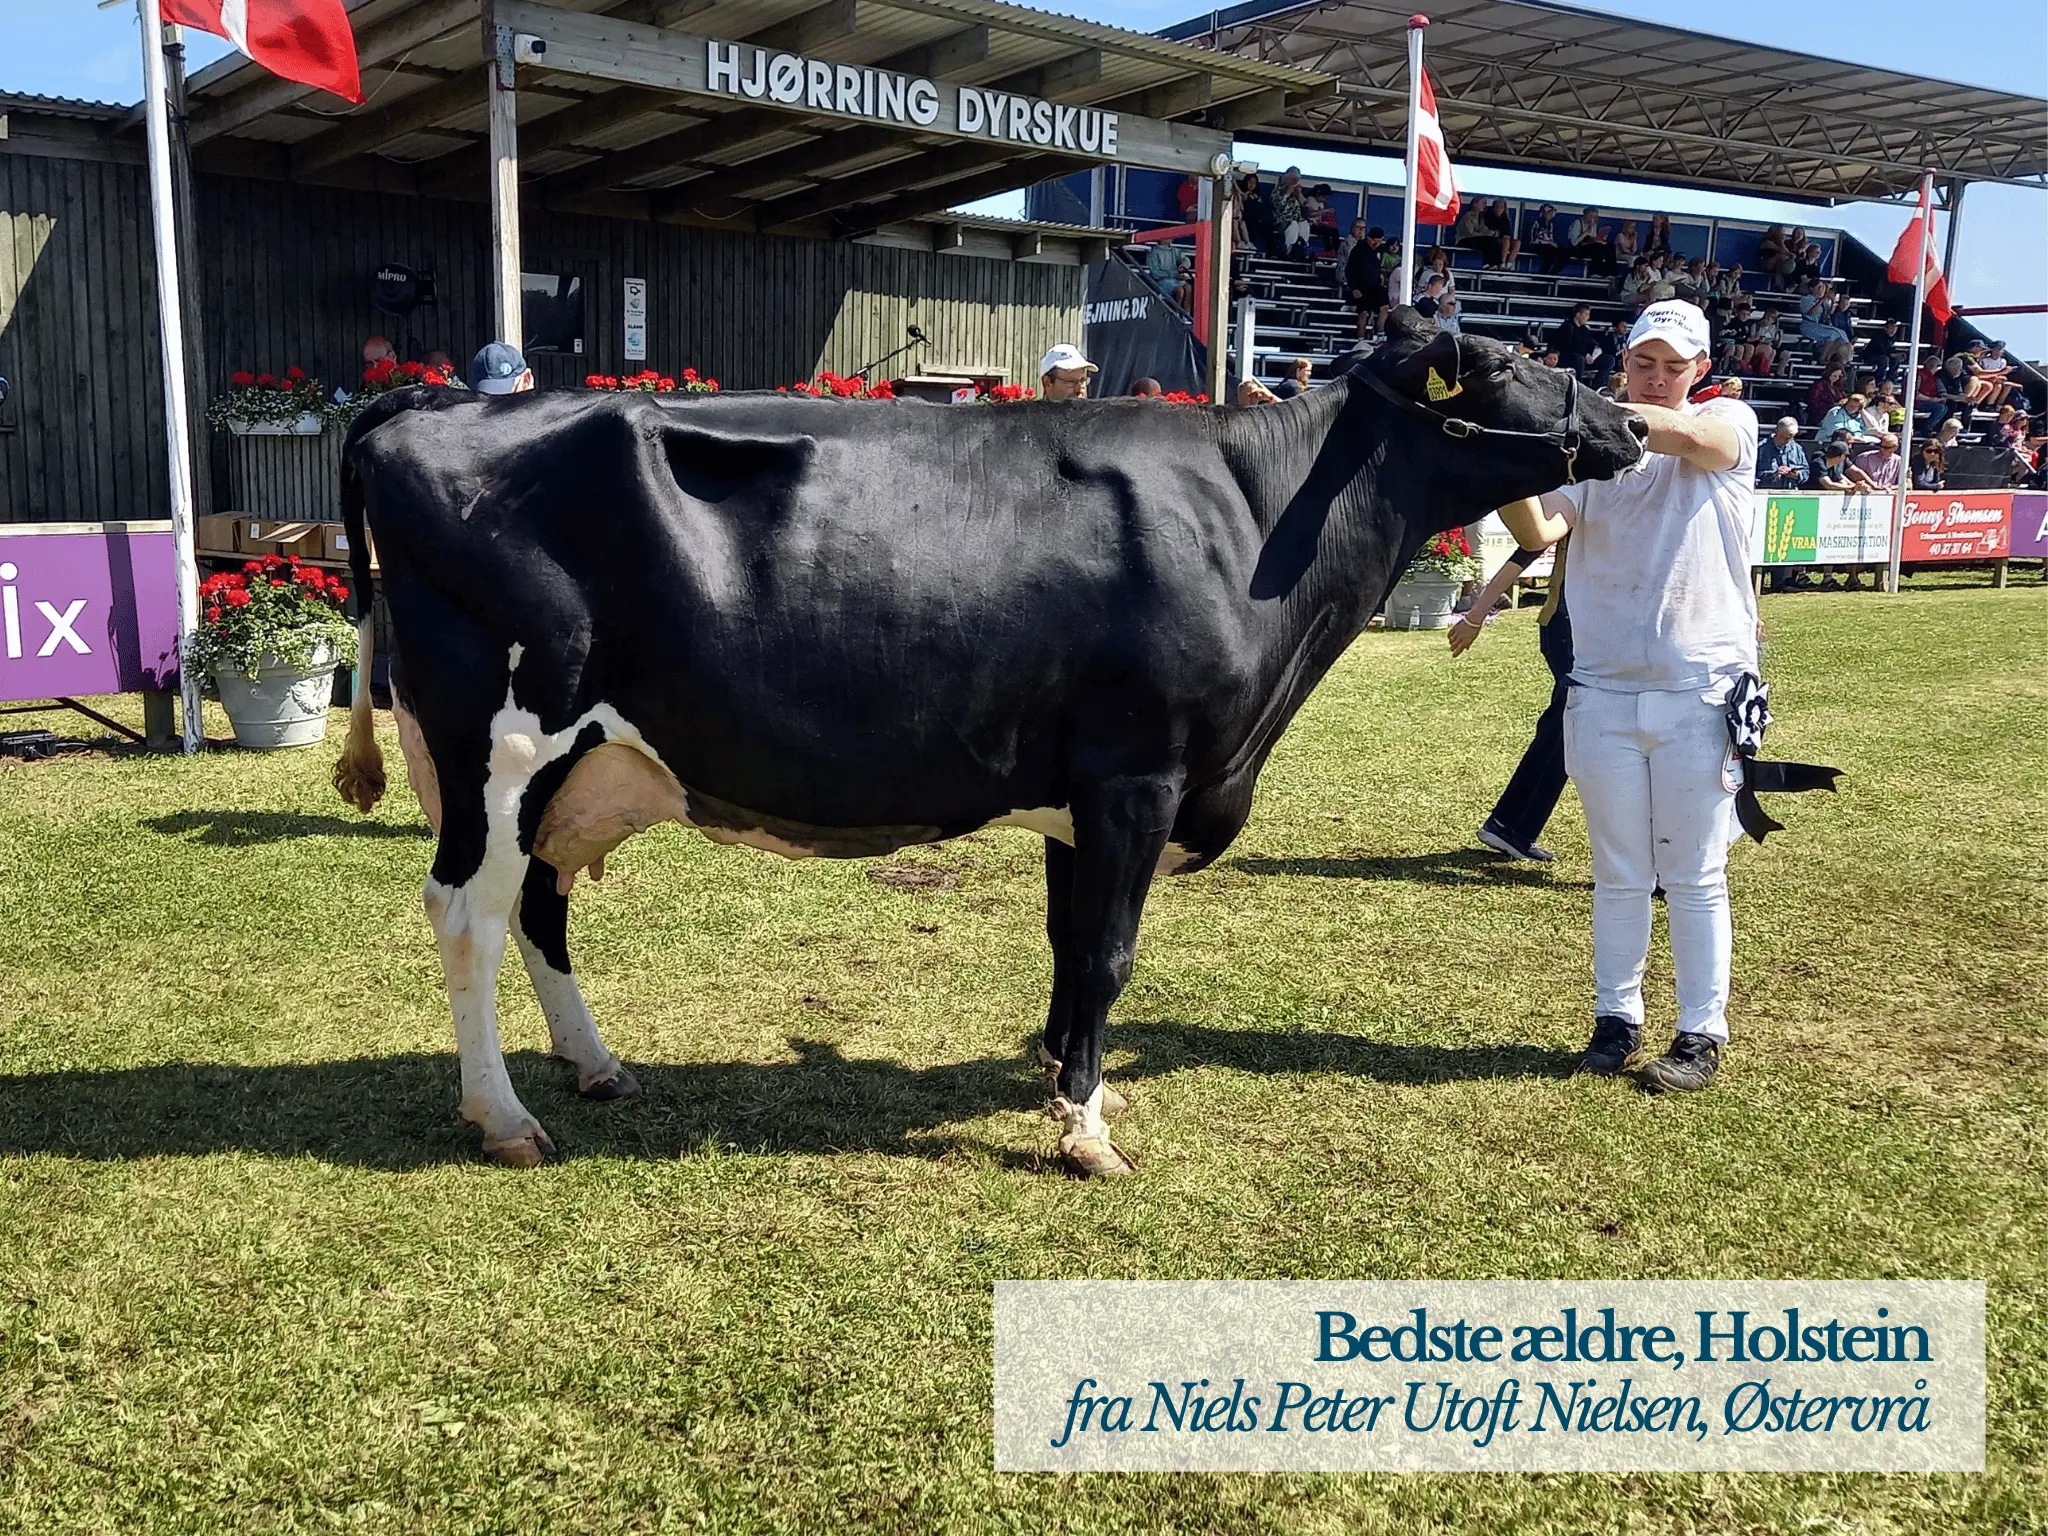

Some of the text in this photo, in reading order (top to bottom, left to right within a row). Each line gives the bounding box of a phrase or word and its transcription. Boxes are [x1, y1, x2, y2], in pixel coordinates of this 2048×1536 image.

[707, 40, 1119, 156] HJØRRING DYRSKUE
[1945, 500, 2004, 526] Thomsen
[1791, 535, 1889, 550] VRAA MASKINSTATION
